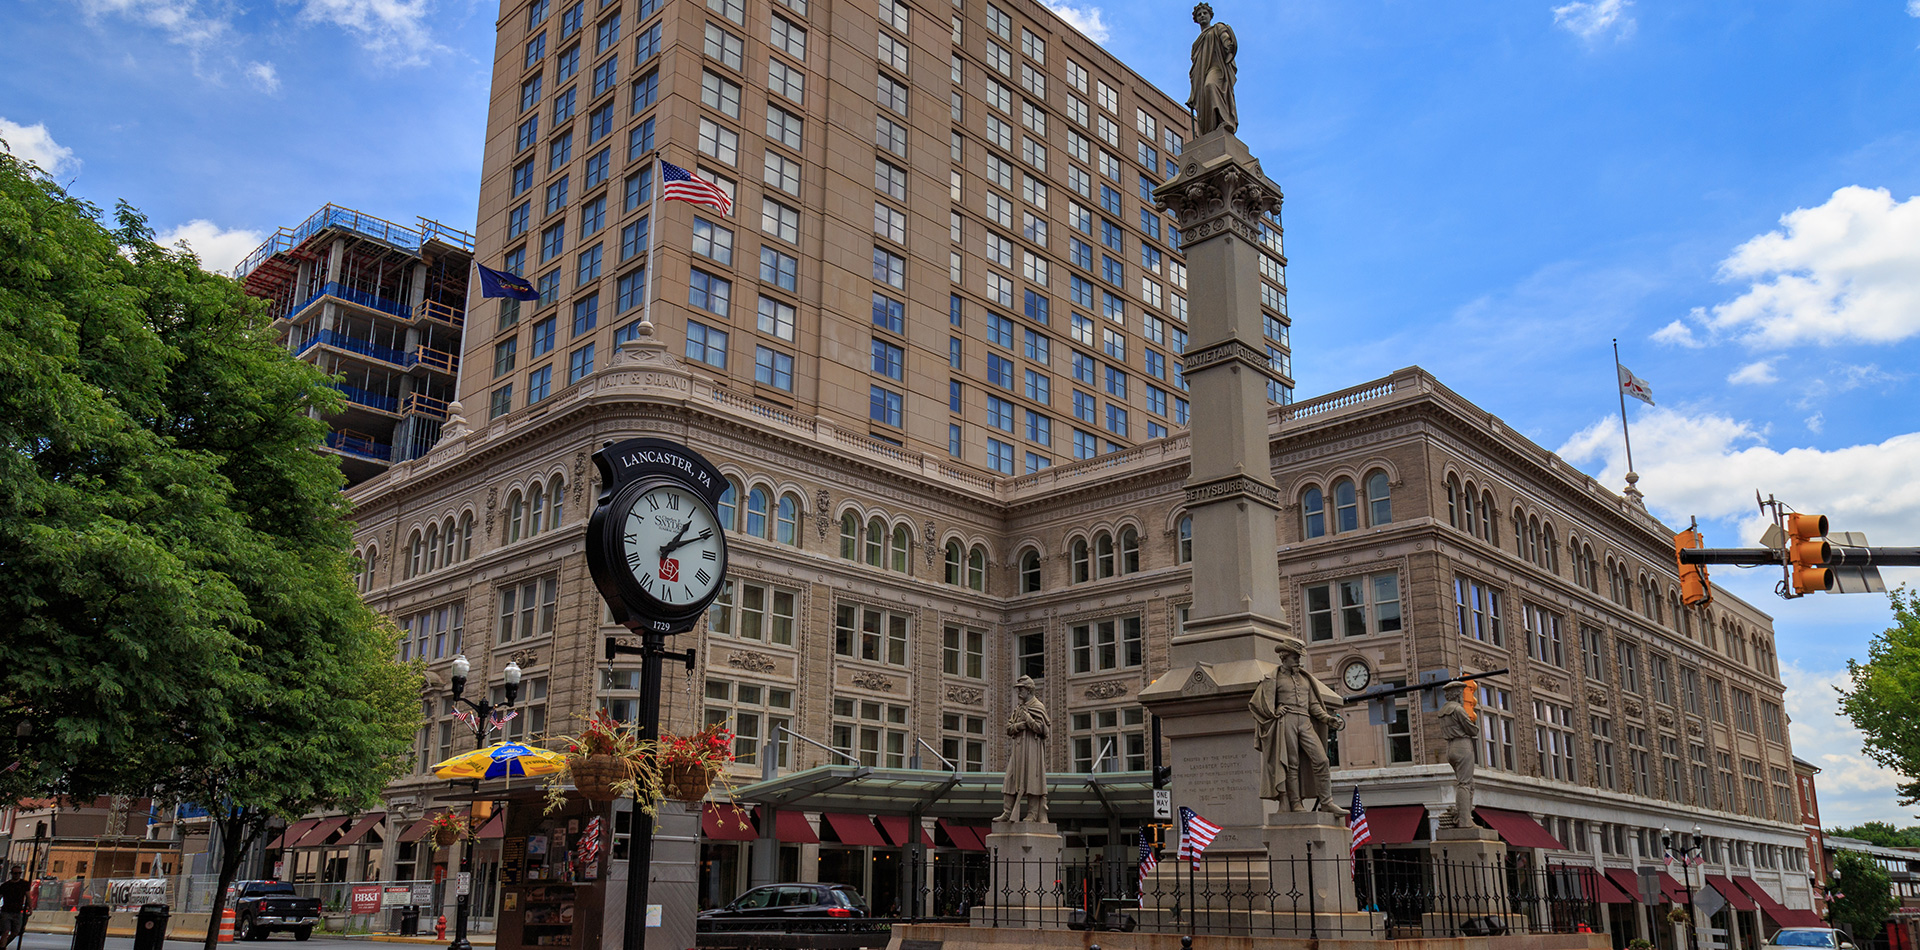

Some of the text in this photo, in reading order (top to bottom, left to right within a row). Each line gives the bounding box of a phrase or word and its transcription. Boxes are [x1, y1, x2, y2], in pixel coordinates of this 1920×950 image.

[1186, 345, 1233, 368] ANTIETAM
[600, 372, 688, 391] WATT & SHAND
[621, 450, 711, 488] LANCASTER, PA
[1186, 480, 1242, 500] GETTYSBURG
[653, 620, 670, 632] 1729
[354, 892, 380, 902] BB&T
